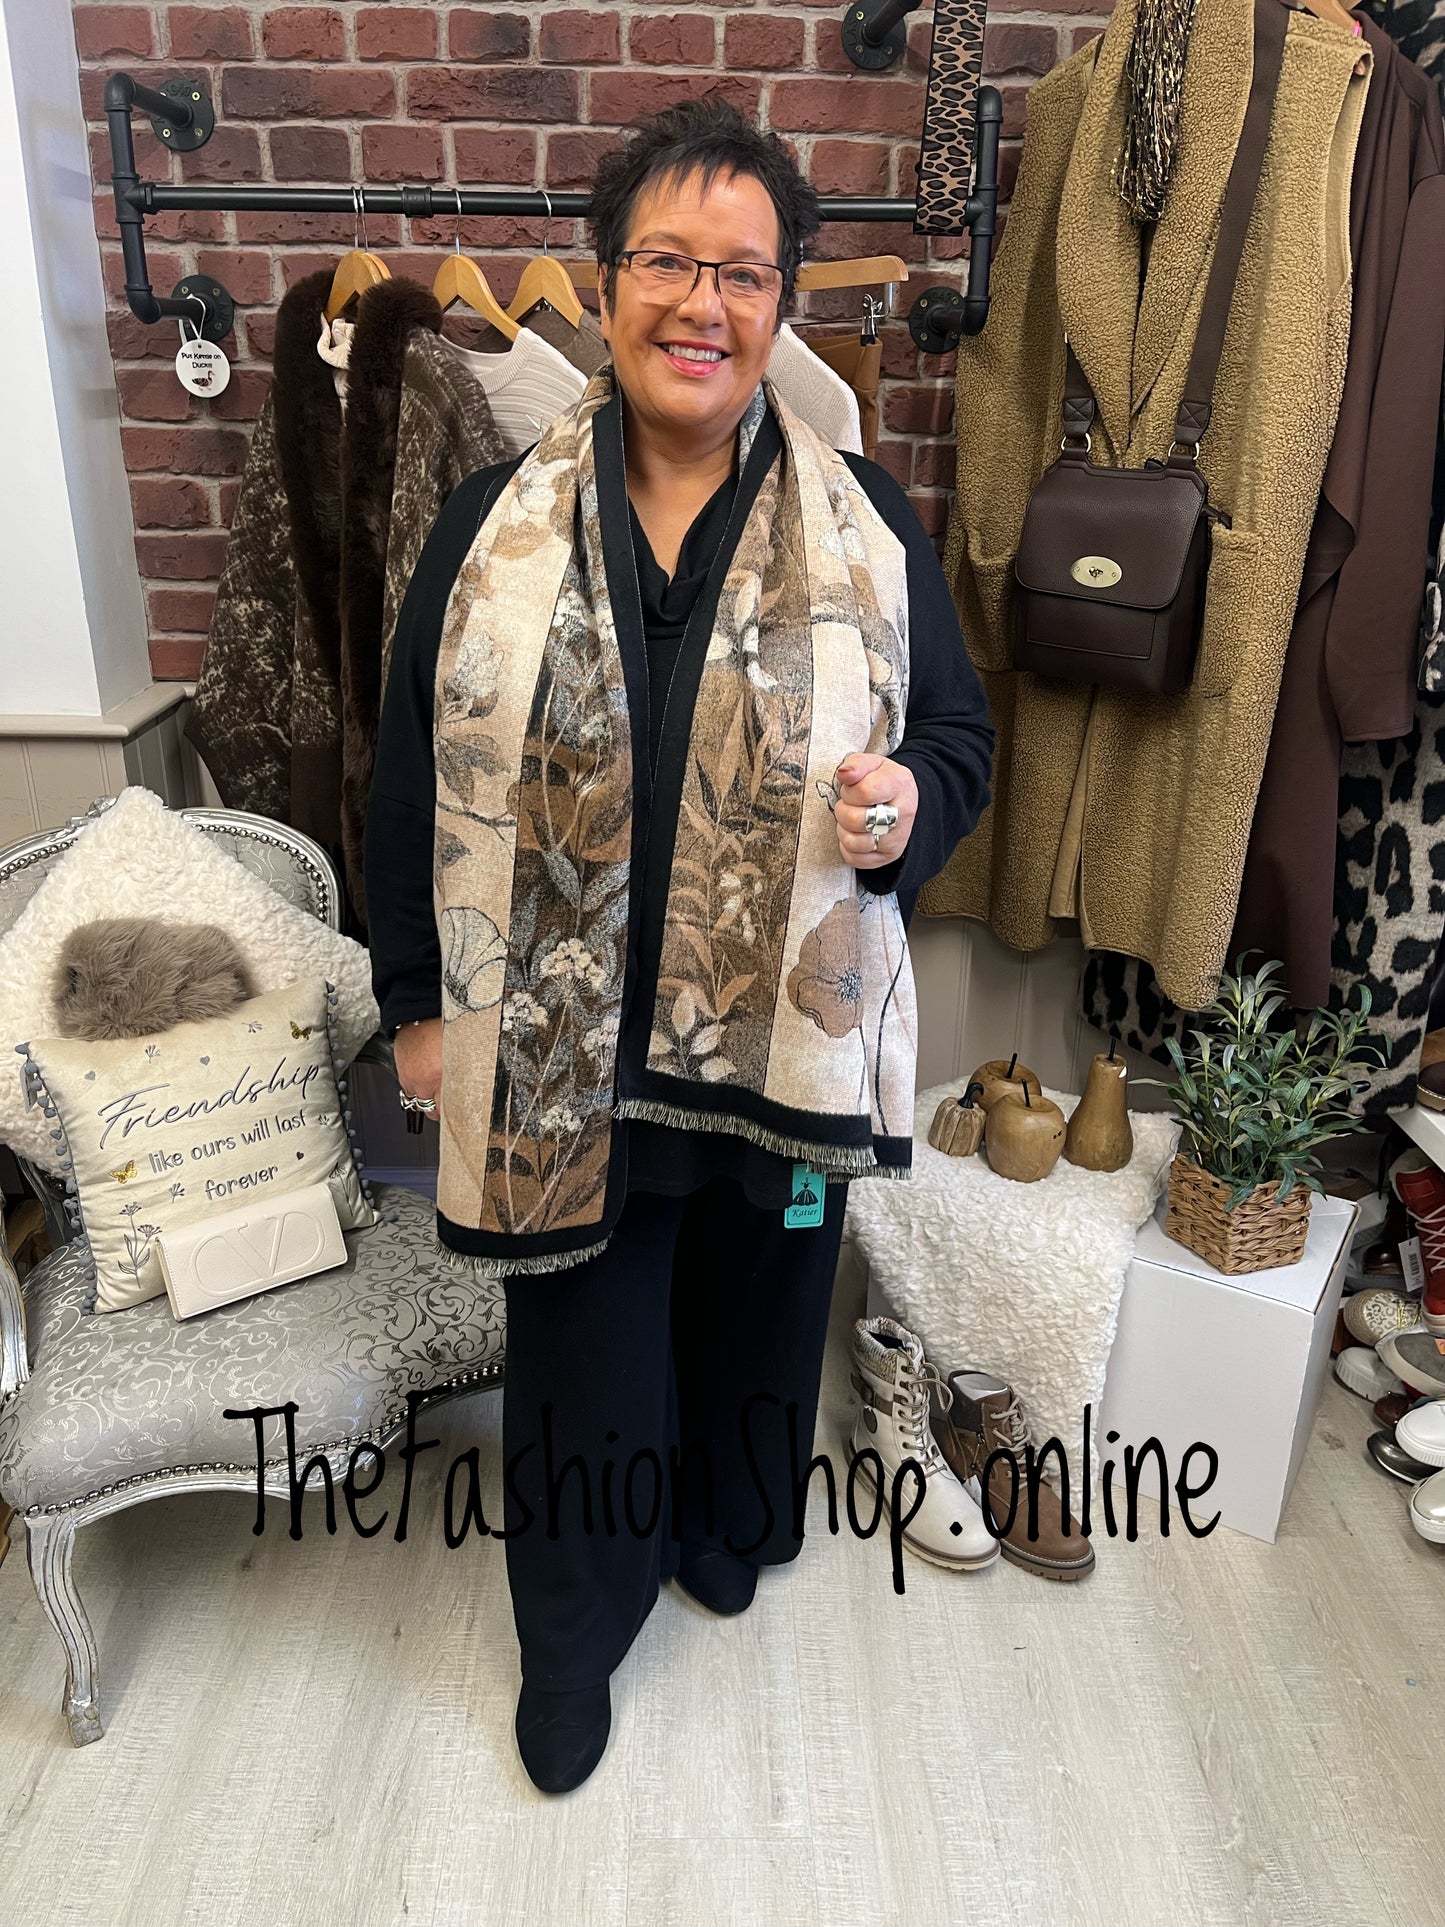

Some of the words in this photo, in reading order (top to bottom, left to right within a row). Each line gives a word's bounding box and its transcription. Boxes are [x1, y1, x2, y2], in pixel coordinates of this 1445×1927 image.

[98, 1057, 320, 1150] Friendship
[149, 1150, 184, 1173] like
[190, 1137, 237, 1161] ours
[241, 1118, 271, 1145] will
[275, 1109, 307, 1134] last
[204, 1164, 279, 1200] forever
